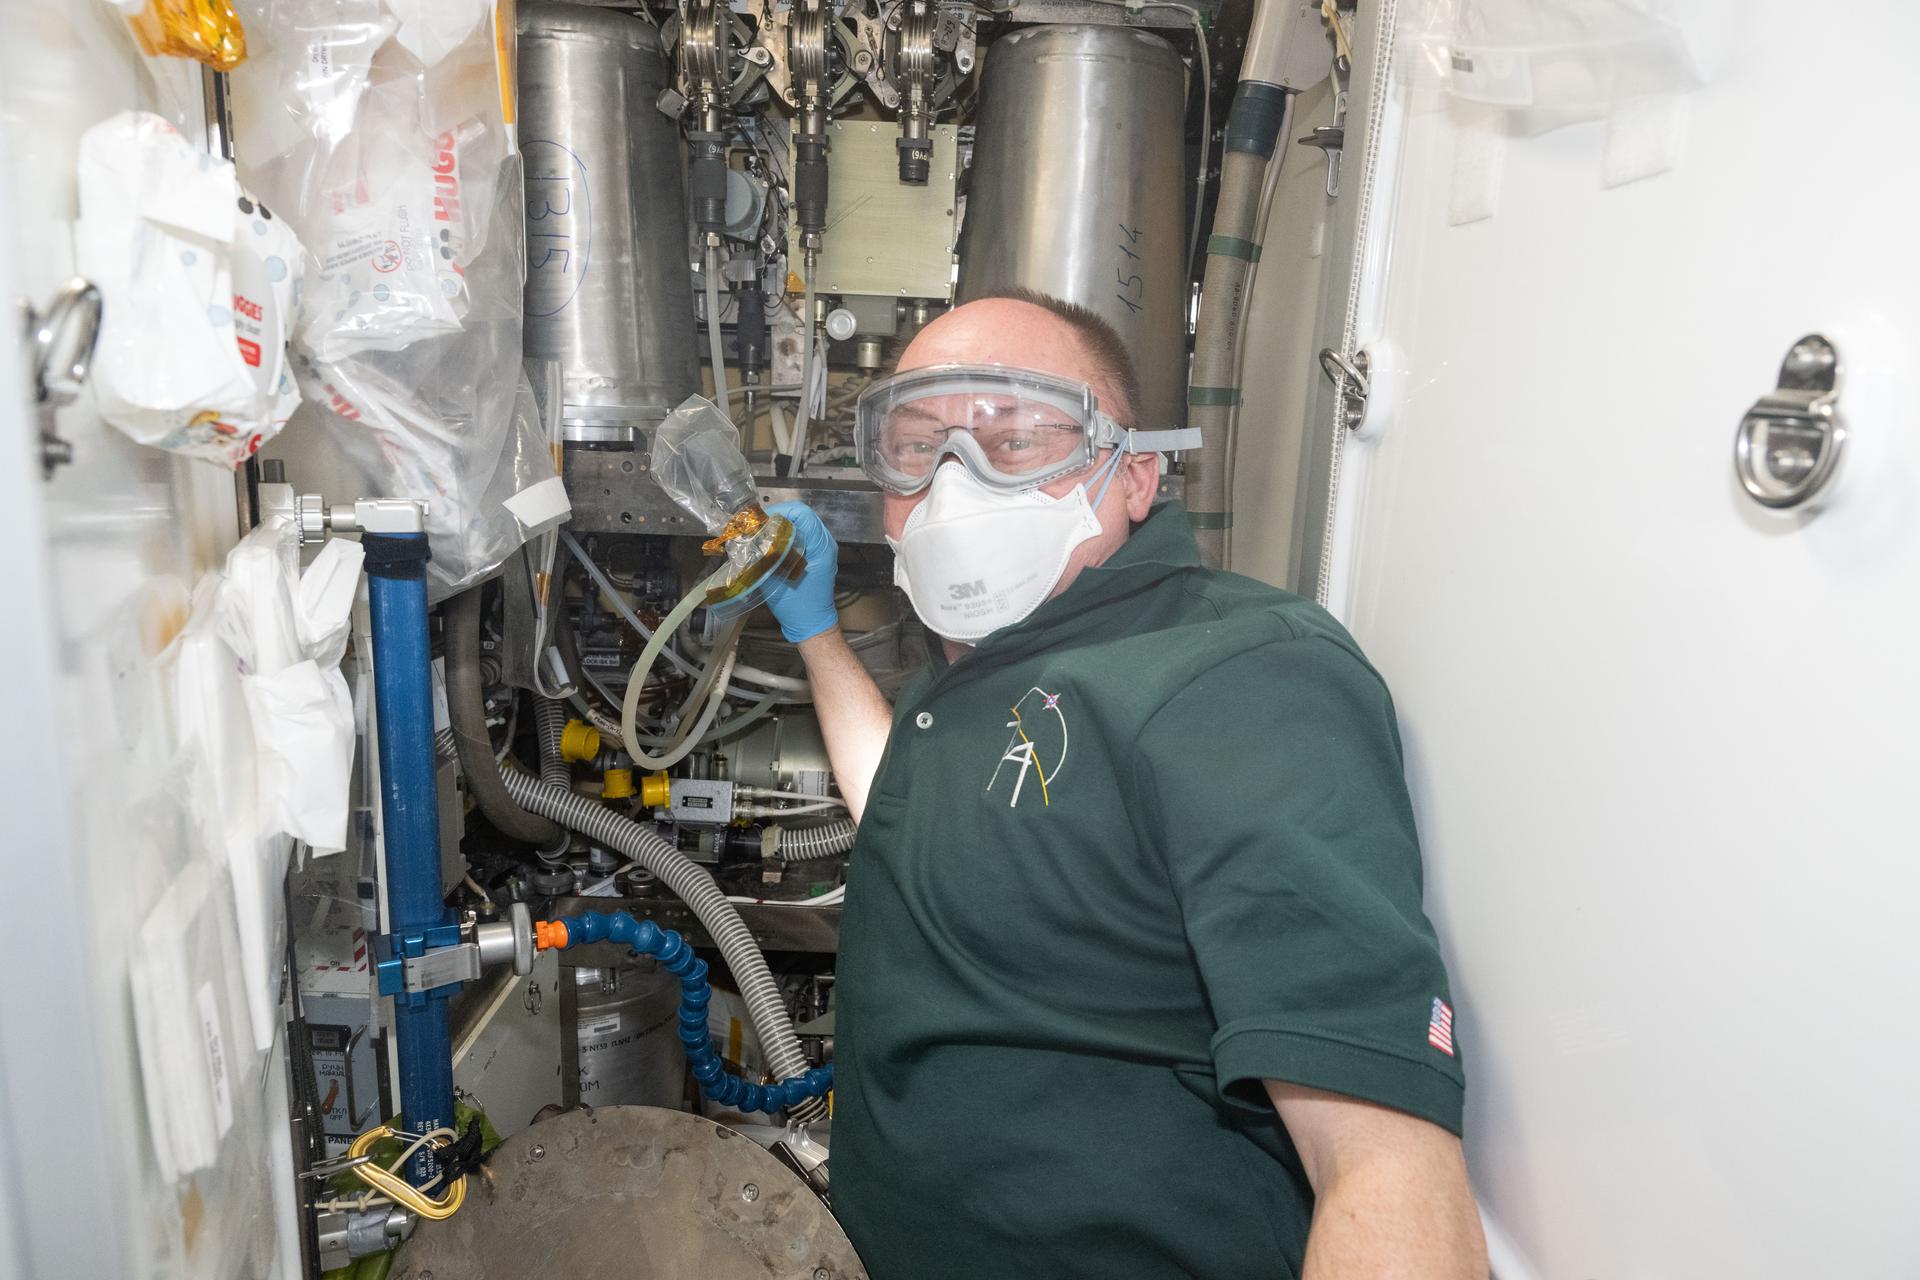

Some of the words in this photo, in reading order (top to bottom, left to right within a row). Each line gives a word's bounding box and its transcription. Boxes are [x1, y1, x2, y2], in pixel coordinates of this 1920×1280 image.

[525, 176, 570, 273] 1315
[1117, 223, 1143, 314] 1514
[948, 579, 987, 600] 3M
